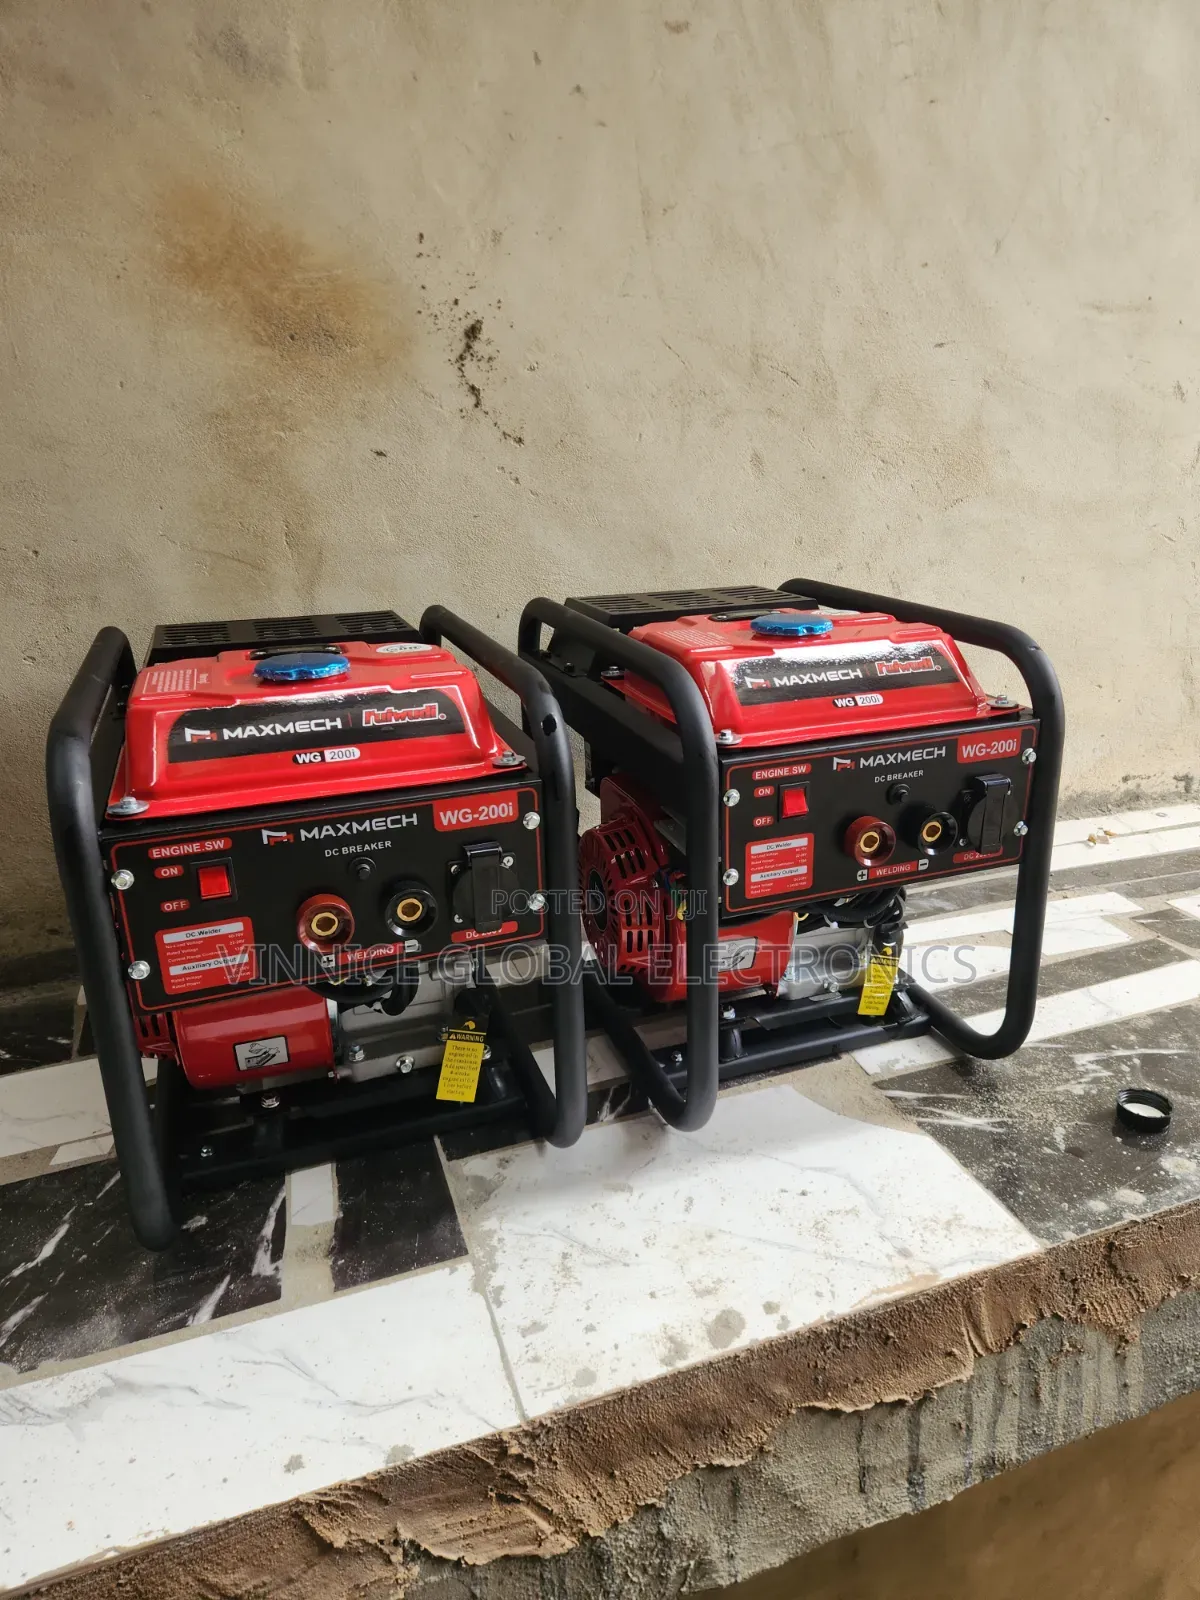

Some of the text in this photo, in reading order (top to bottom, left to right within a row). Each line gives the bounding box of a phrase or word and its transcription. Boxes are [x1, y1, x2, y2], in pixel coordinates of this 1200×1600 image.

[773, 668, 863, 688] MAXMECH
[834, 694, 881, 708] WG 200i
[223, 718, 342, 740] MAXMECH
[296, 749, 356, 764] WG 200i
[962, 739, 1017, 759] WG-200i
[859, 746, 946, 769] MAXMECH
[755, 765, 807, 780] ENGINE.SW
[874, 769, 924, 783] DC BREAKER
[758, 788, 771, 796] ON
[440, 802, 514, 826] WG-200i
[300, 813, 418, 841] MAXMECH
[755, 818, 772, 826] OFF
[152, 839, 225, 858] ENGINE.SW
[325, 840, 392, 857] DC BREAKER
[963, 852, 975, 860] DC
[161, 867, 178, 877] ON
[876, 864, 911, 876] WELDING
[164, 900, 187, 911] OFF
[465, 930, 480, 939] DC
[347, 946, 394, 962] WELDING
[457, 1033, 484, 1042] WARNING
